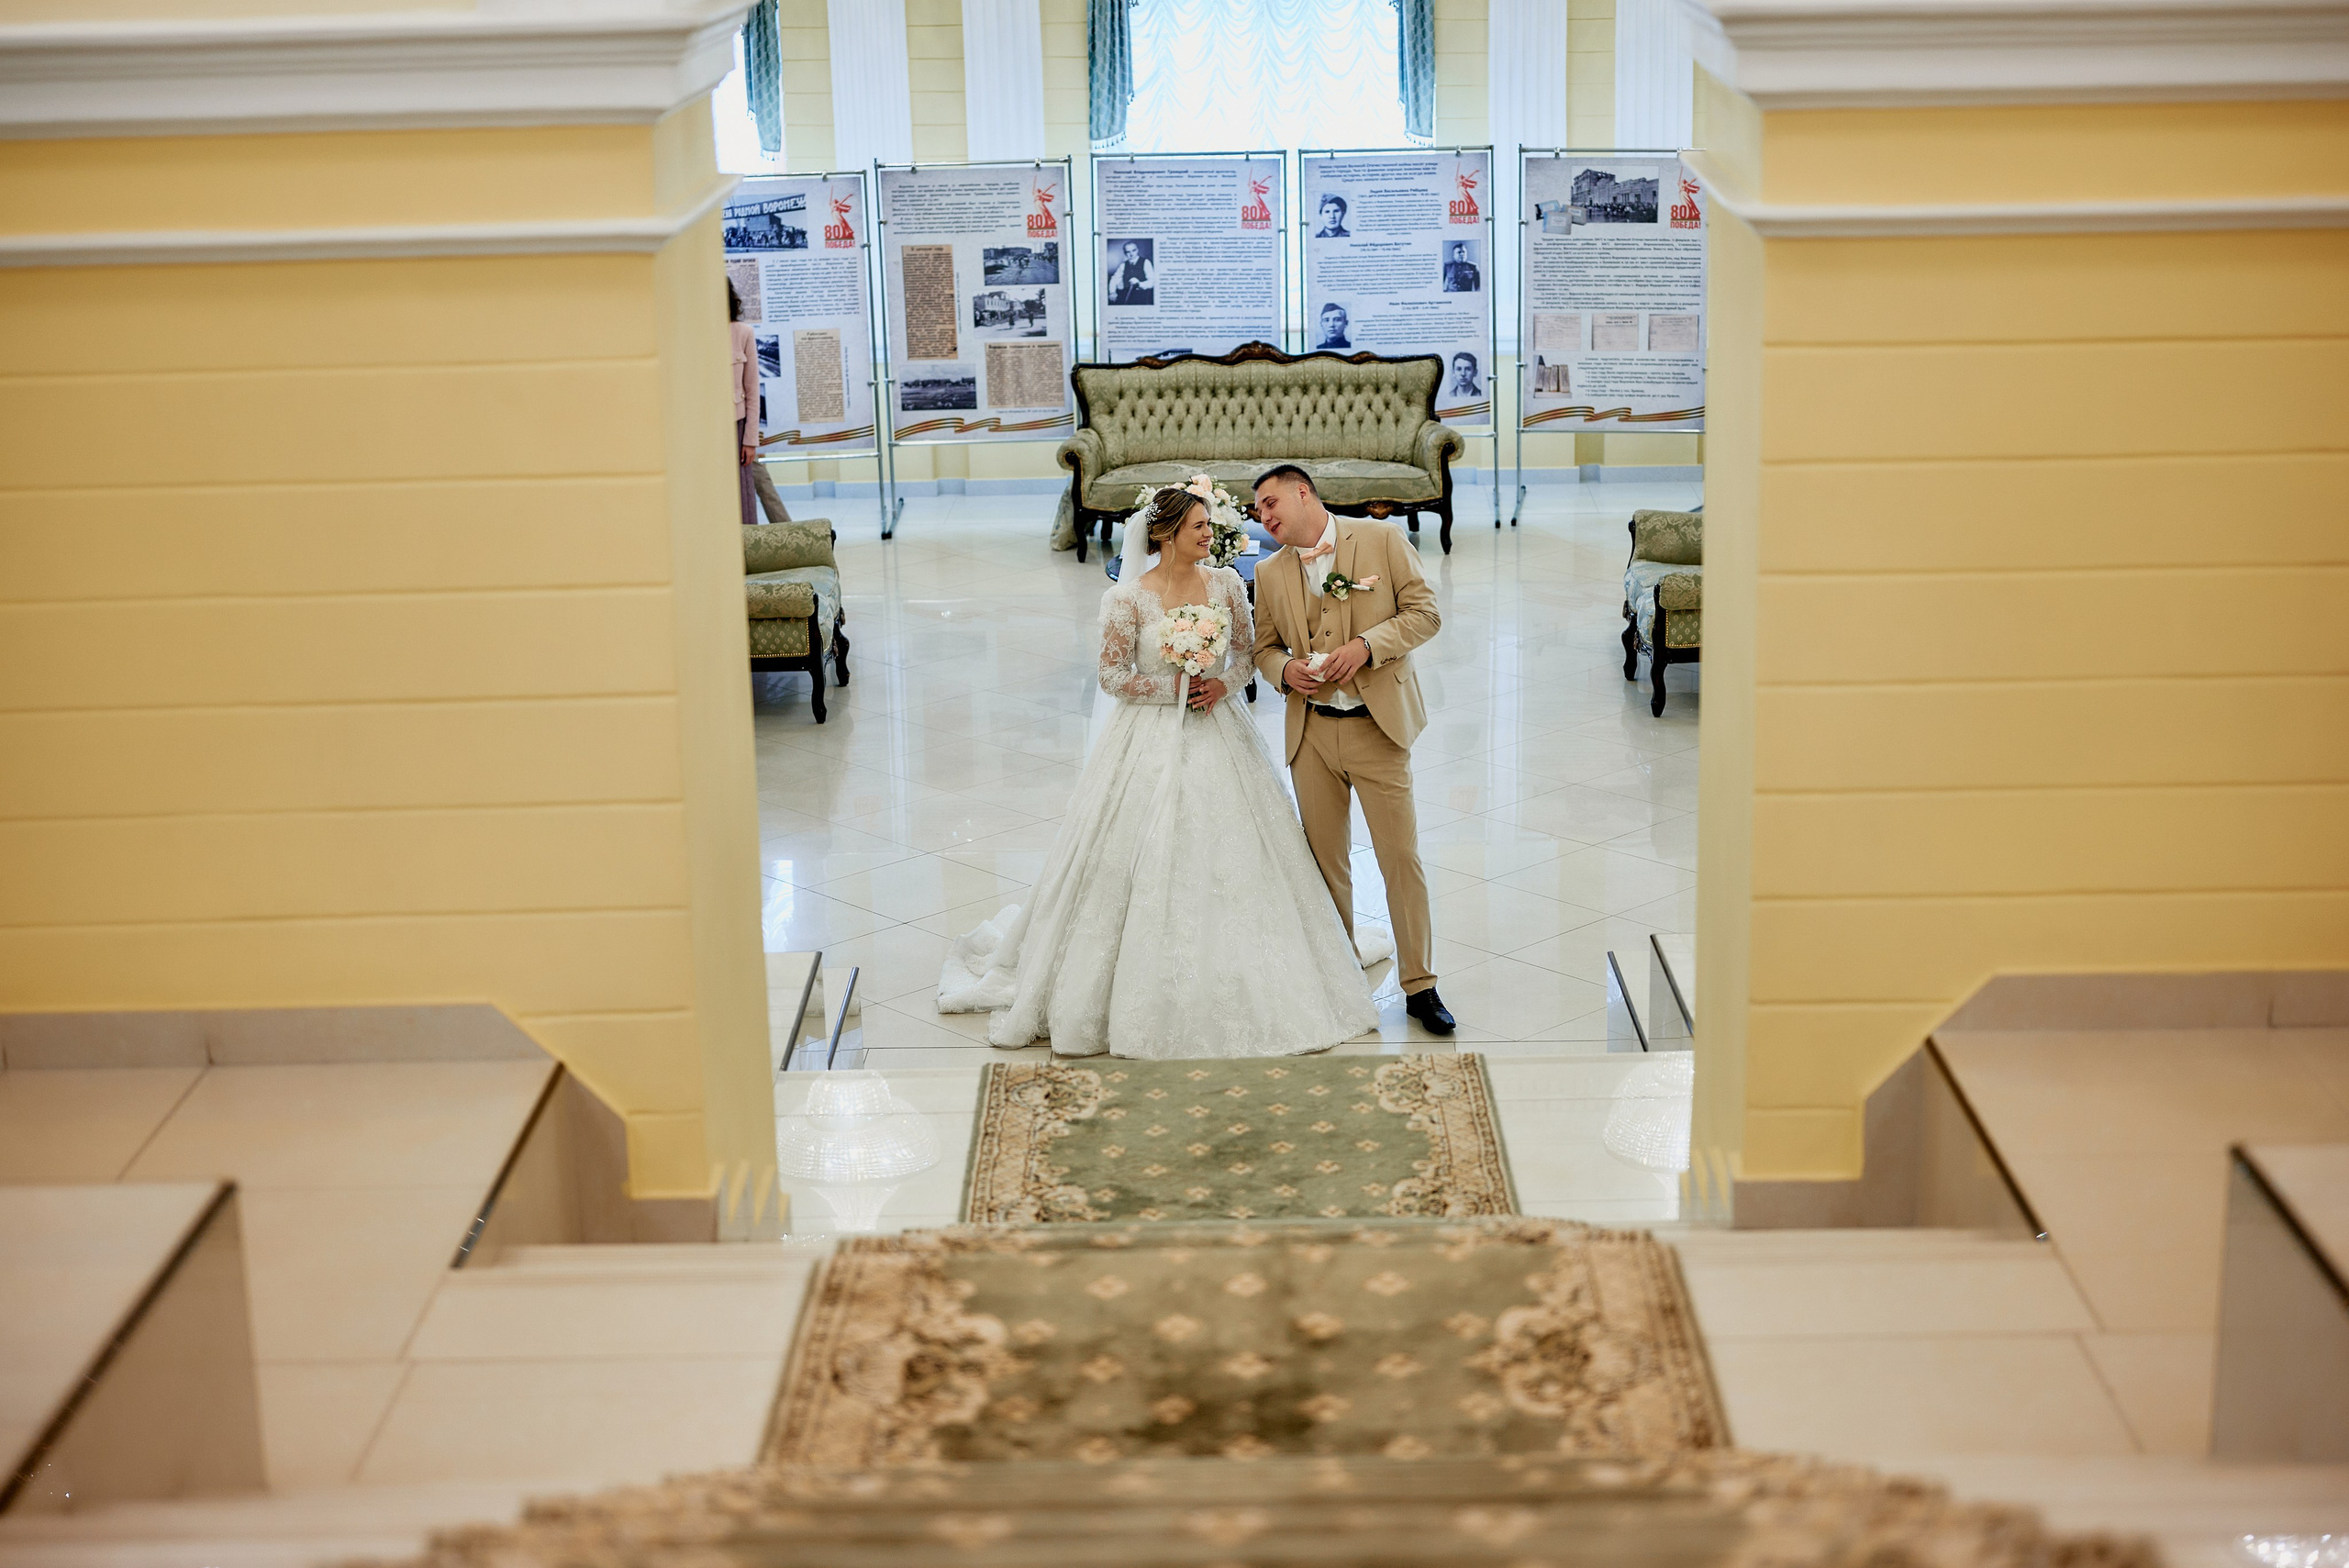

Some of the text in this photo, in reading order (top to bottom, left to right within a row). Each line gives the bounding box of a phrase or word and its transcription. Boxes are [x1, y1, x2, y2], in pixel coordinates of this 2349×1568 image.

[1241, 206, 1257, 220] 80
[1449, 200, 1465, 216] 80
[1671, 205, 1687, 219] 80
[1027, 214, 1042, 228] 80
[1449, 217, 1479, 225] ПОБЕДА!
[1670, 221, 1701, 229] ПОБЕДА!
[824, 226, 840, 239] 80
[1028, 229, 1058, 238] ПОБЕДА!
[825, 240, 855, 249] ПОБЕДА!
